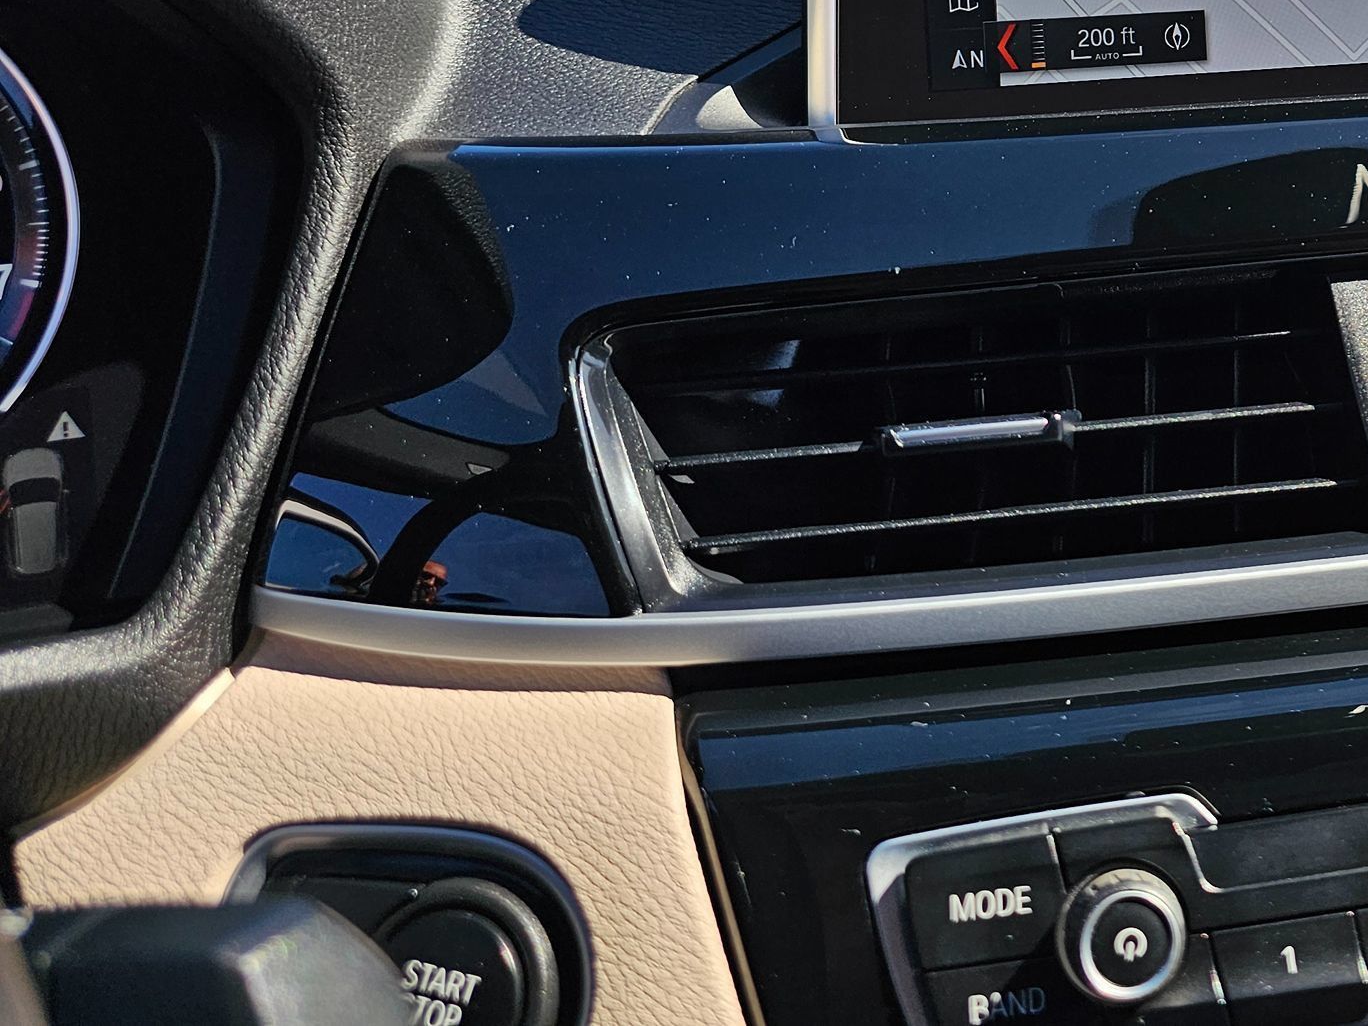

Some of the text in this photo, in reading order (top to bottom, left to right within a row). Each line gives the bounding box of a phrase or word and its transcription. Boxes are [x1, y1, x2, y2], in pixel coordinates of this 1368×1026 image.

[1077, 26, 1136, 48] 200 ft
[1094, 52, 1120, 61] AUTO
[948, 885, 1033, 923] MODE
[1280, 945, 1298, 974] 1
[401, 959, 482, 1006] START
[967, 986, 1046, 1026] BAND
